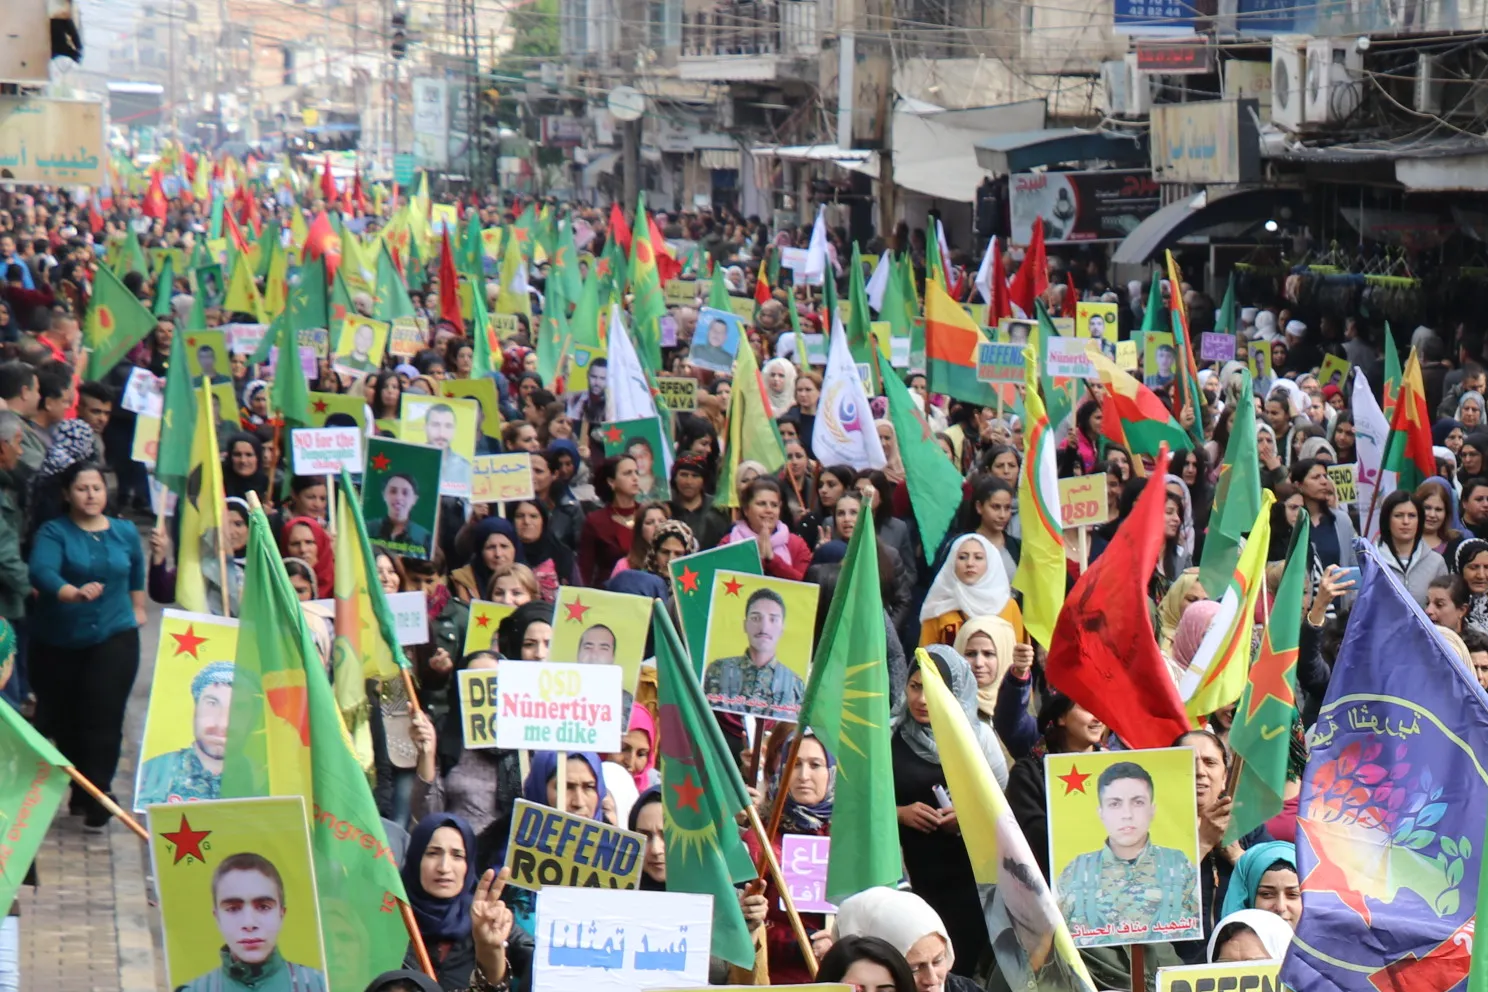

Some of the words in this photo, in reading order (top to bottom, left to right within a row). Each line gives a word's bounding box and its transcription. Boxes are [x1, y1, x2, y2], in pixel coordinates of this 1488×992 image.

[1061, 500, 1099, 525] QSD
[537, 668, 582, 701] QSD
[501, 692, 612, 727] Nûnertiya
[523, 717, 551, 742] me
[555, 721, 597, 744] dike
[514, 806, 642, 877] DEFEND
[1116, 920, 1149, 934] مناف
[1152, 917, 1198, 933] الشهيد
[547, 919, 626, 972] تمثلنا
[633, 924, 689, 972] قسد
